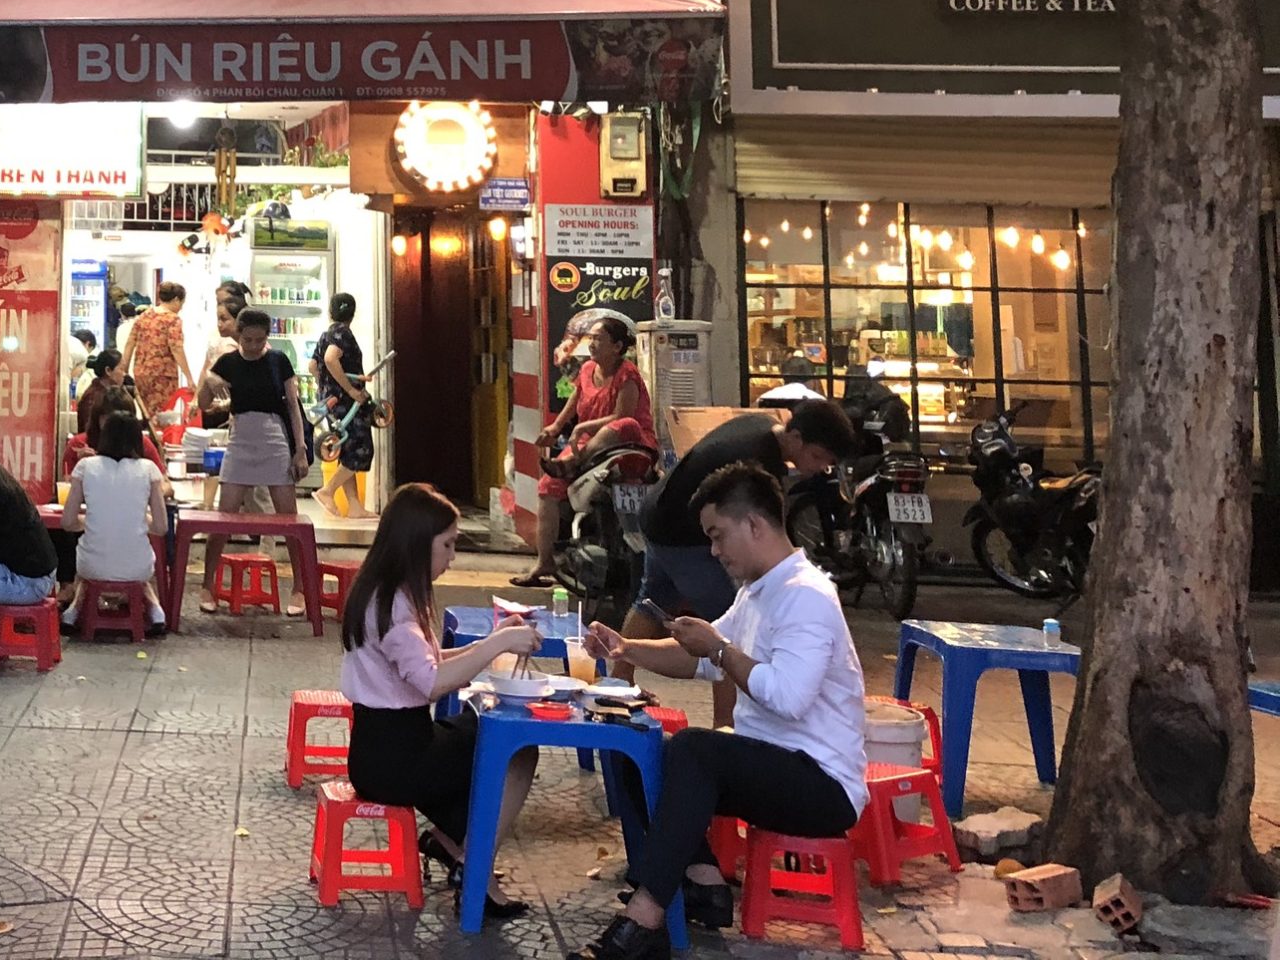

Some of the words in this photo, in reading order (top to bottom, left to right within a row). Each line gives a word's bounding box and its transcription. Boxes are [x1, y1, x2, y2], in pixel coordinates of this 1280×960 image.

[77, 33, 193, 82] BÚN
[213, 32, 341, 82] RIÊU
[361, 31, 532, 82] GÁNH
[212, 87, 242, 98] PHAN
[376, 86, 404, 97] 0908
[559, 207, 588, 217] SOUL
[592, 208, 638, 218] BURGER
[558, 220, 600, 229] OPENING
[603, 220, 639, 230] HOURS:
[580, 262, 648, 279] Burgers
[572, 275, 650, 307] Soul
[895, 508, 926, 521] 2523
[356, 803, 387, 817] Coca-Cola
